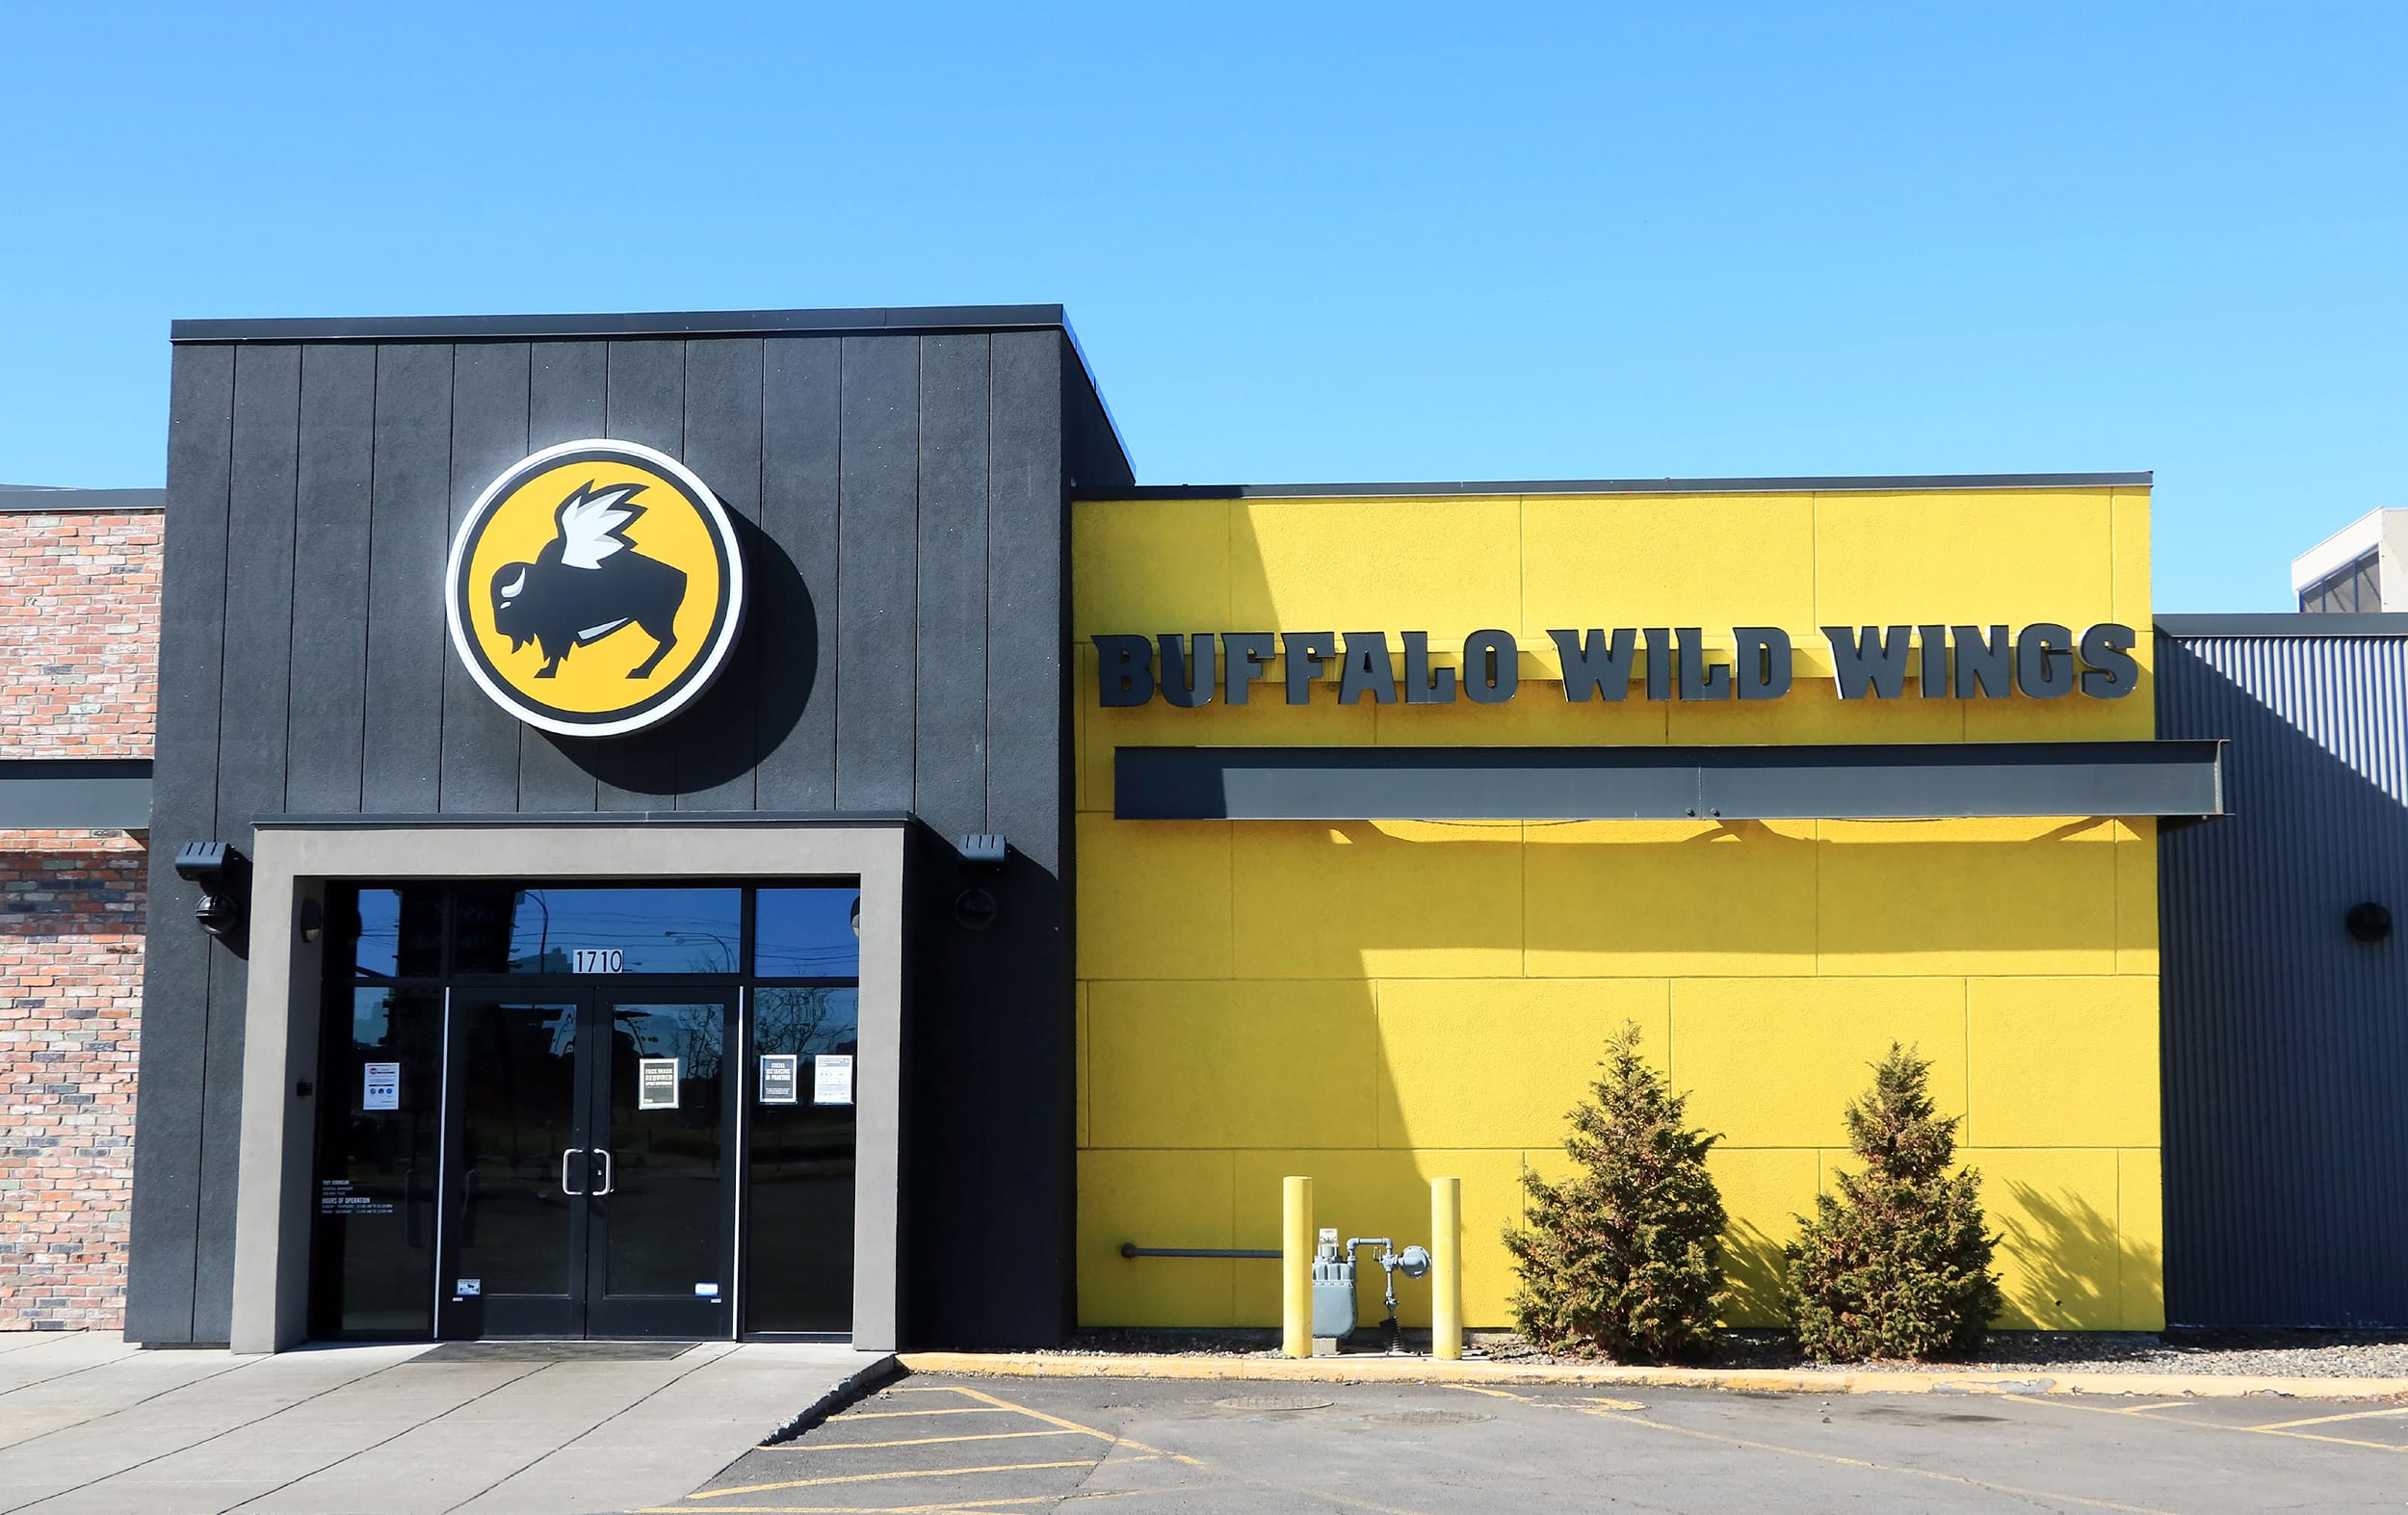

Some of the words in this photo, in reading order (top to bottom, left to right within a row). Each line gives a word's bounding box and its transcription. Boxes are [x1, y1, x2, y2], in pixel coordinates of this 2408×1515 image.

[1090, 629, 1519, 708] BUFFALO
[1546, 625, 1793, 703] WILD
[1819, 622, 2138, 701] WINGS
[577, 951, 622, 973] 1710
